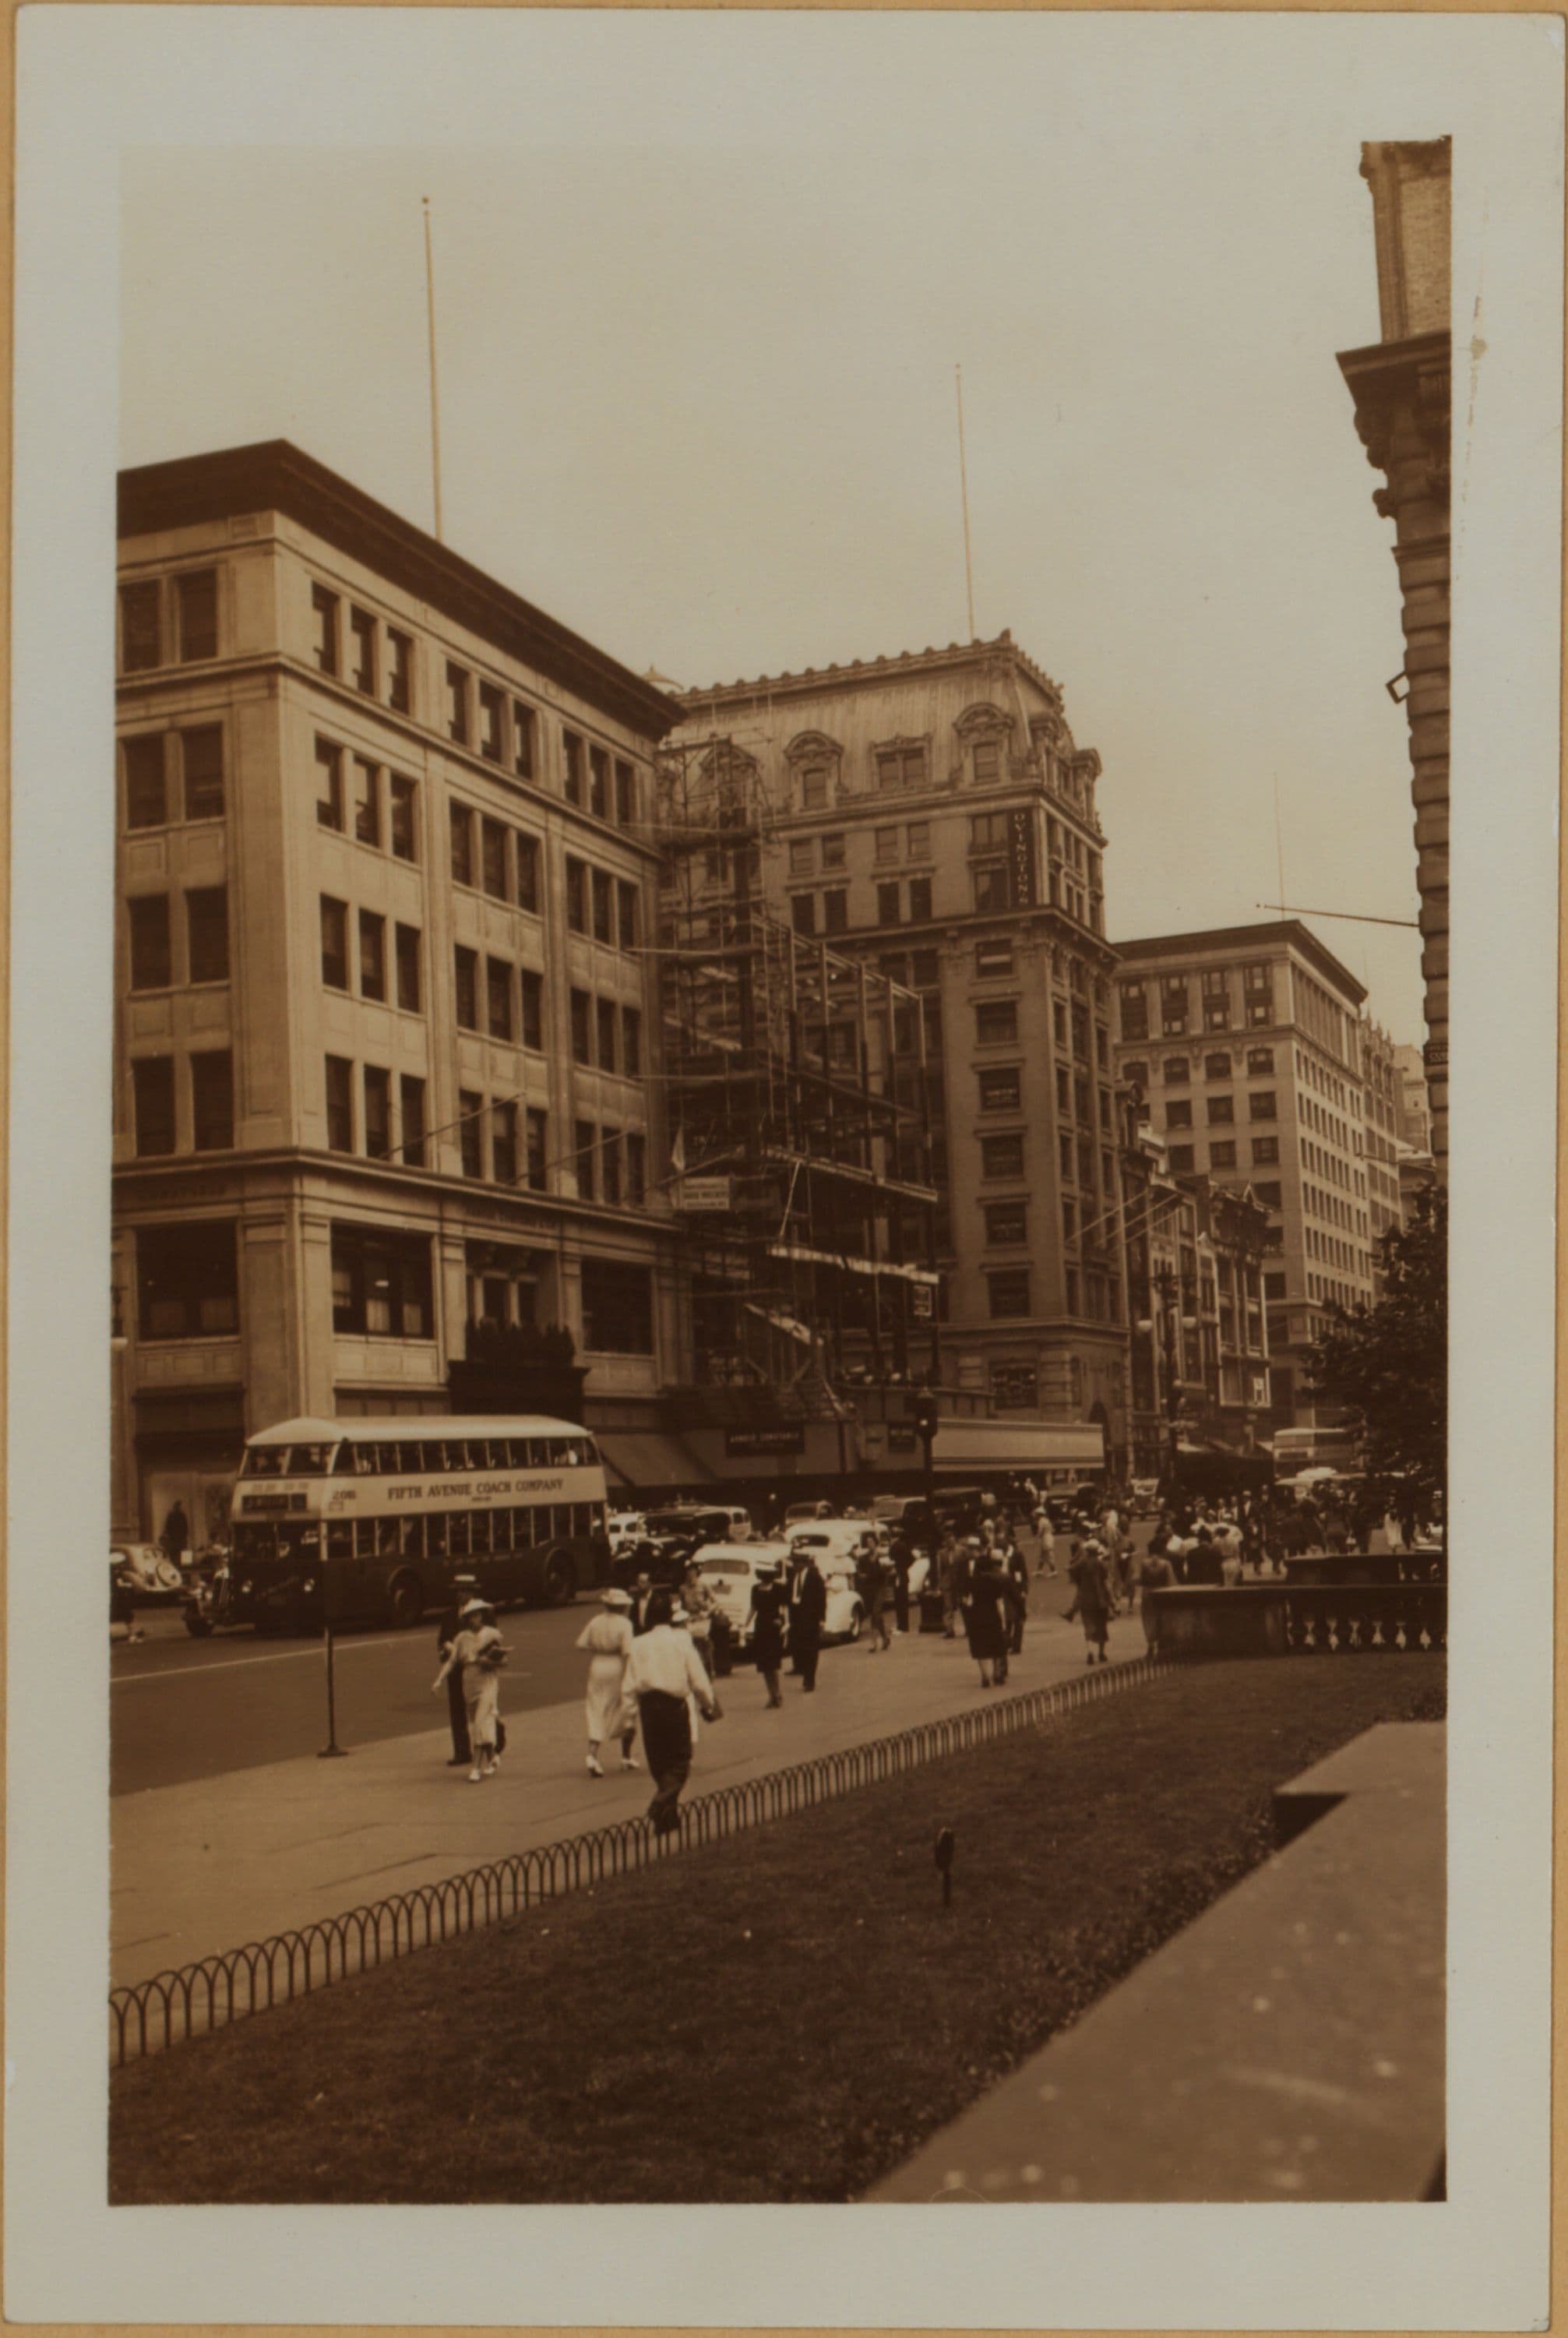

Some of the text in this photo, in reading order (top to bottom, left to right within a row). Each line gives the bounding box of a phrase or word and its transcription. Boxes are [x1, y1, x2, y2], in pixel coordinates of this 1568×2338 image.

[388, 1477, 563, 1500] FIFTH AVENUE COACH COMPANY
